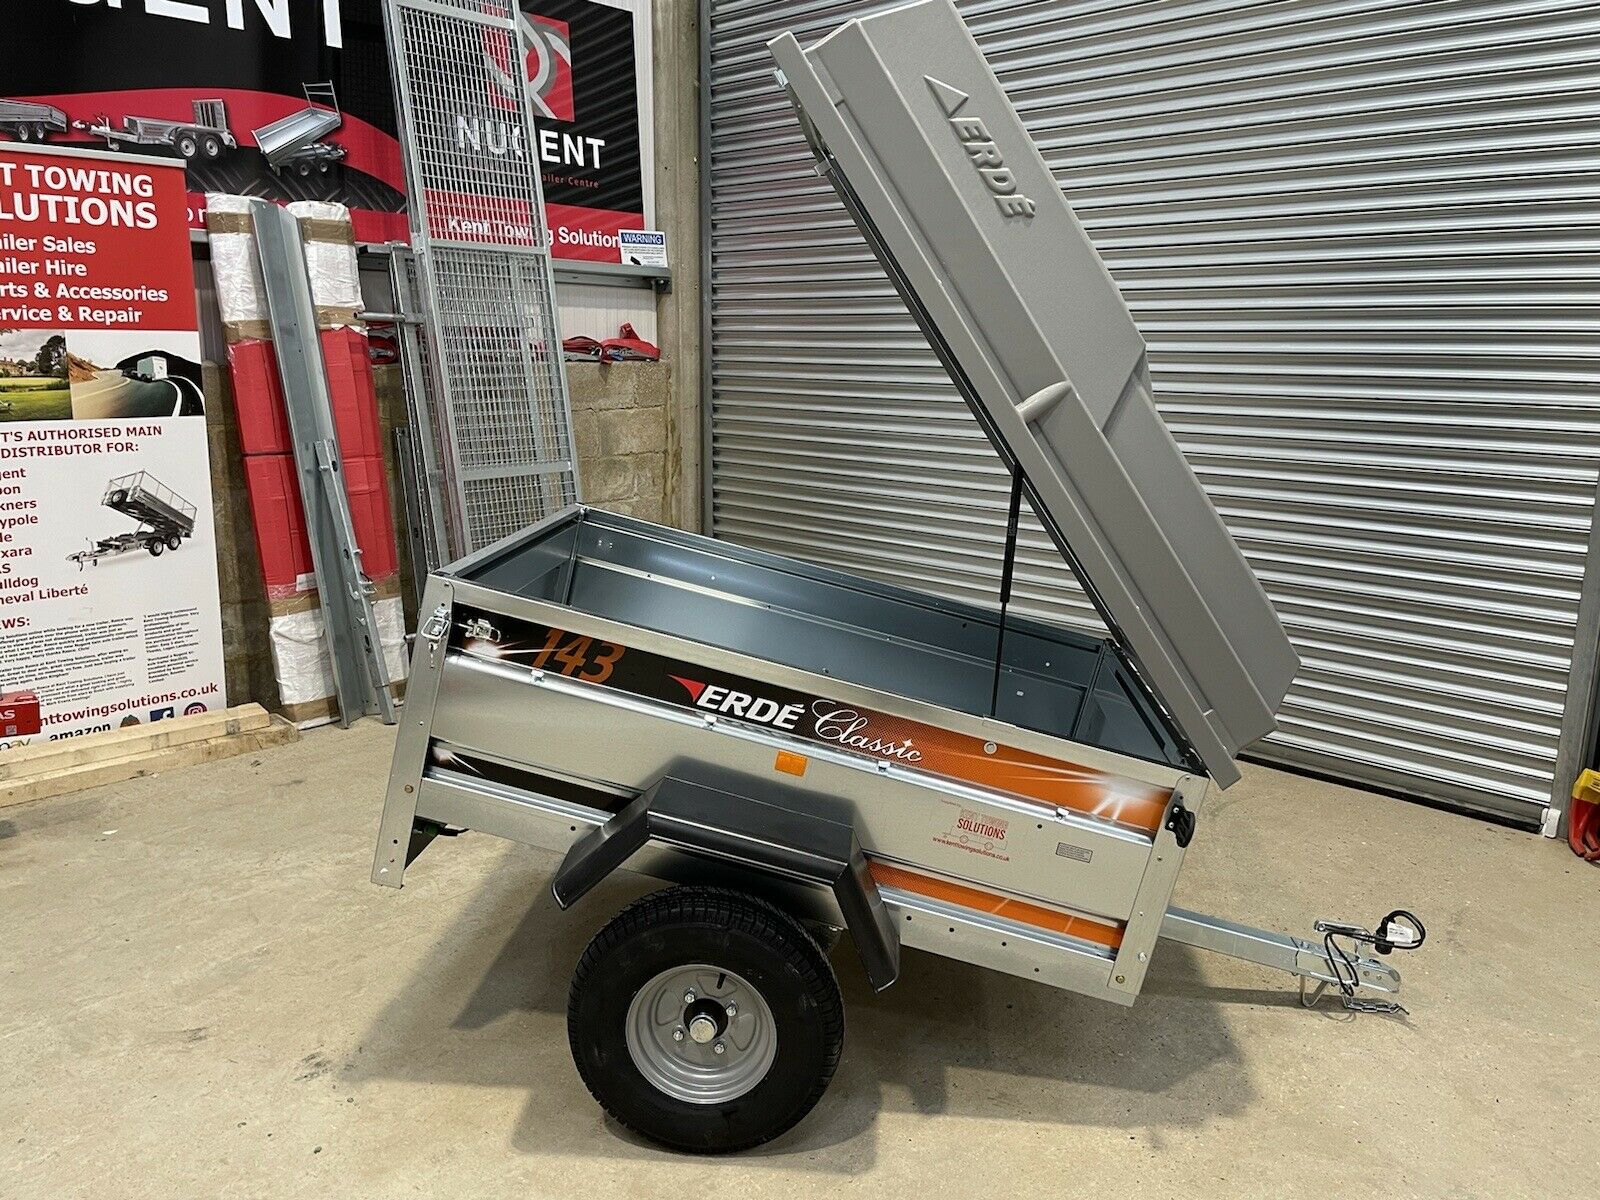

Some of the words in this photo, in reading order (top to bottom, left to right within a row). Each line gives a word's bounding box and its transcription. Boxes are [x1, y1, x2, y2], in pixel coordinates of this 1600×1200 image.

[950, 116, 1036, 219] ERDÉ
[24, 164, 154, 198] TOWING
[567, 176, 600, 189] Centre
[0, 233, 37, 251] iler
[43, 235, 97, 254] Sales
[622, 233, 662, 244] WARNING
[46, 259, 88, 276] Hire
[34, 281, 51, 298] &
[56, 283, 169, 302] Accessories
[0, 305, 52, 321] rvice
[58, 305, 73, 322] &
[78, 306, 142, 325] Repair
[0, 431, 23, 442] T'S
[27, 427, 121, 442] AUTHORISED
[126, 425, 162, 437] MAIN
[1, 443, 102, 459] DISTRIBUTOR
[106, 442, 139, 453] FOR:
[0, 467, 26, 480] ent
[39, 583, 89, 600] Liberté
[0, 616, 30, 630] WS:
[532, 628, 627, 684] 143
[697, 685, 805, 730] ERDÉ
[811, 700, 922, 763] Classic
[957, 818, 1006, 840] SOLUTIONS
